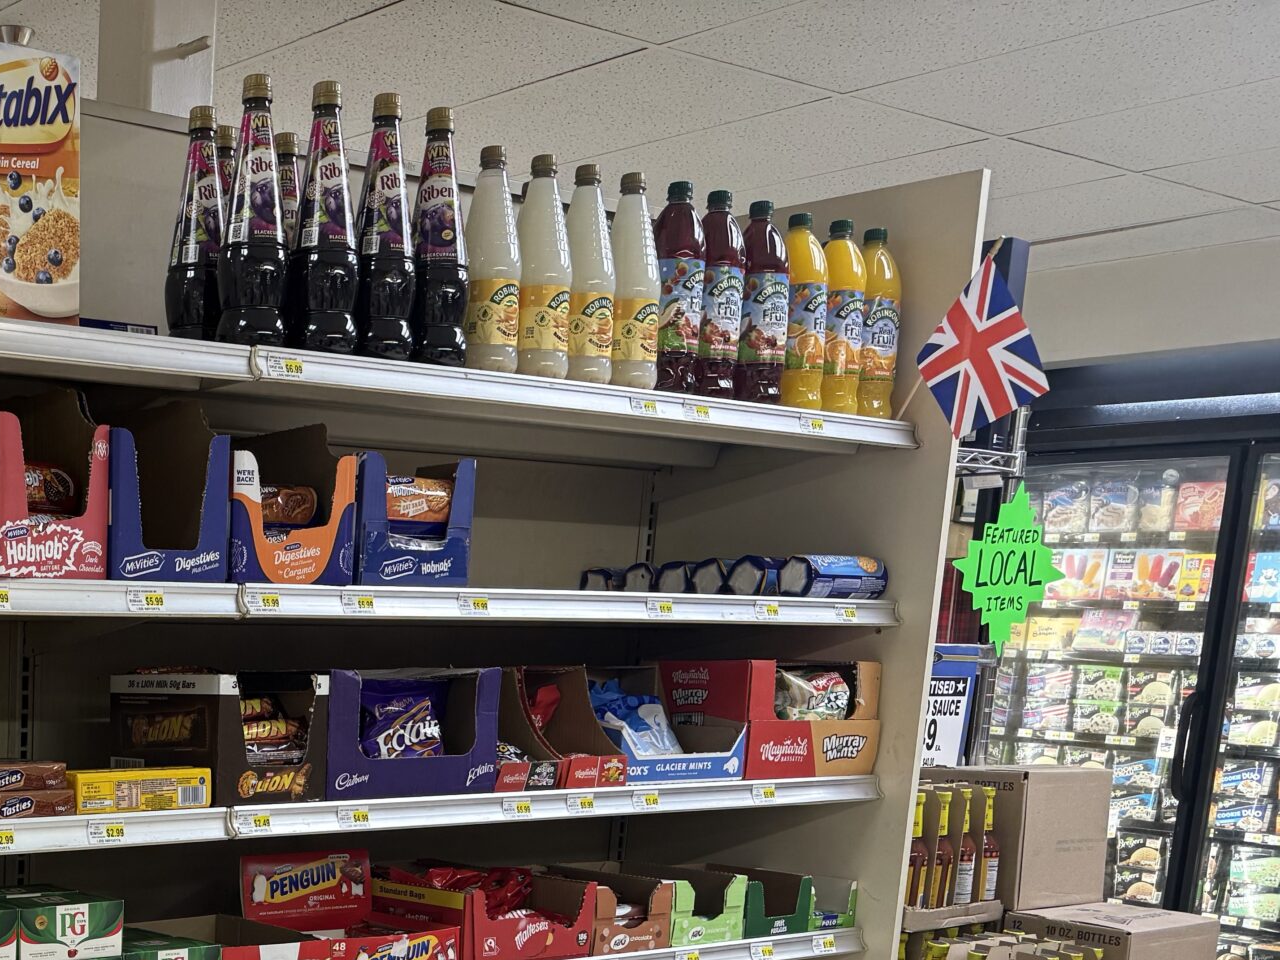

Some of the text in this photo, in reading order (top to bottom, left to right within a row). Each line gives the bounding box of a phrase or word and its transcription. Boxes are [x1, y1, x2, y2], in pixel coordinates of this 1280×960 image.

[13, 158, 40, 171] Cereal
[872, 333, 895, 346] Fruit
[285, 362, 303, 374] $6.99
[237, 469, 255, 477] WE'RE
[237, 475, 255, 484] BACK!
[986, 527, 1039, 545] FEATURED
[7, 536, 69, 563] Hobnobs
[284, 565, 315, 578] Caramel
[975, 548, 1042, 589] LOCAL
[145, 595, 163, 606] $5.99
[986, 596, 1022, 612] ITEMS
[182, 681, 196, 689] Bars
[932, 700, 961, 716] SAUCE
[823, 734, 866, 748] Murray
[656, 761, 711, 772] GLACIER MINTS
[335, 773, 369, 791] Cadbury
[353, 812, 369, 822] $4.99
[106, 828, 124, 838] $2.99
[269, 862, 337, 899] PENGUIN
[333, 942, 346, 952] 48
